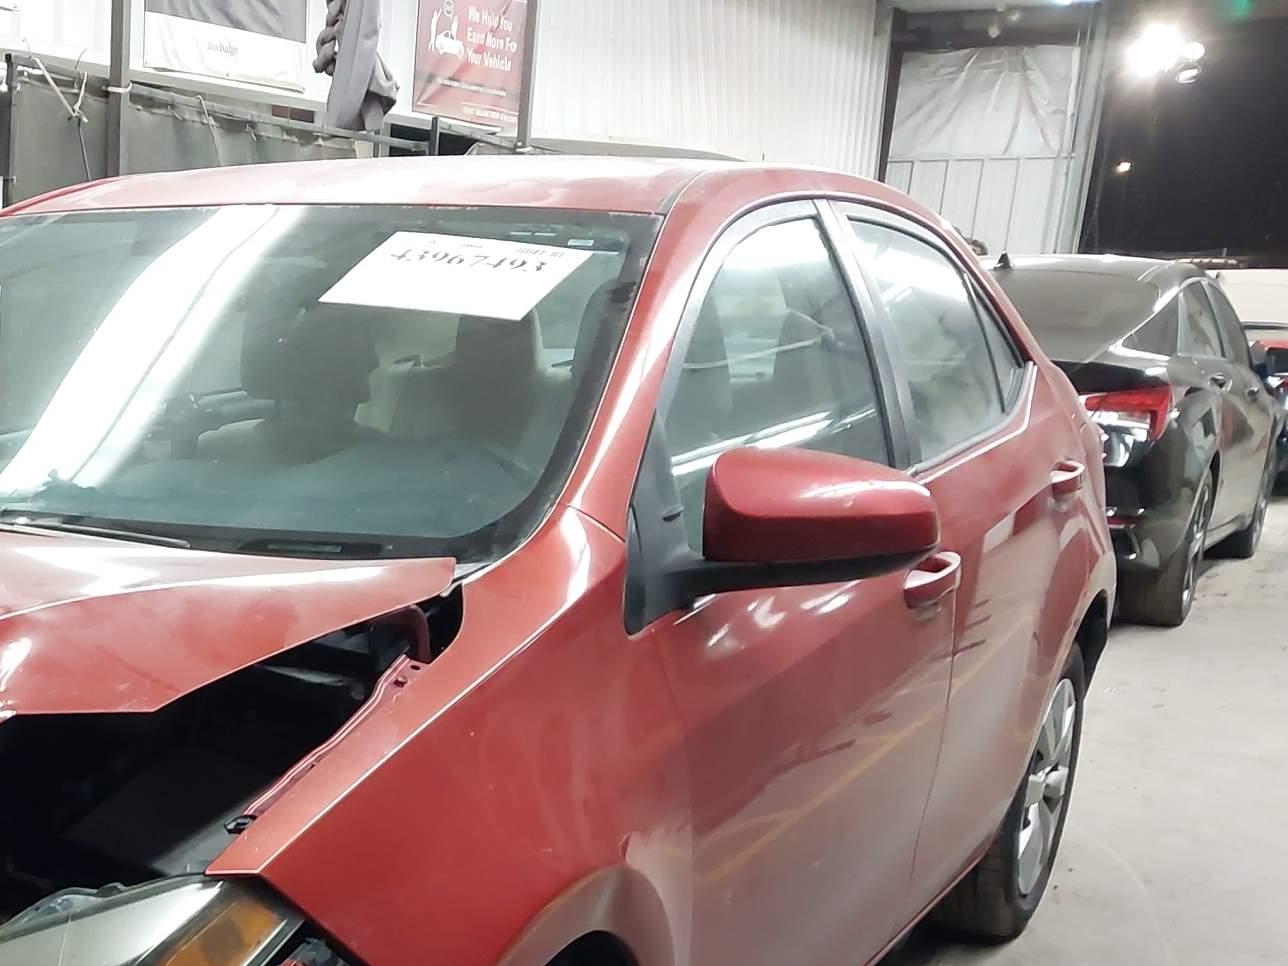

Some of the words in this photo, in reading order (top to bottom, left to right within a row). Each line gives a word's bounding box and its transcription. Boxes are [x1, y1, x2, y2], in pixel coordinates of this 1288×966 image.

[468, 6, 480, 23] We
[482, 9, 499, 29] Help
[500, 14, 513, 32] You
[467, 28, 486, 44] Earn
[485, 31, 504, 50] More
[467, 47, 482, 65] Your
[483, 51, 512, 72] Vehicle
[391, 249, 547, 272] 43967493
